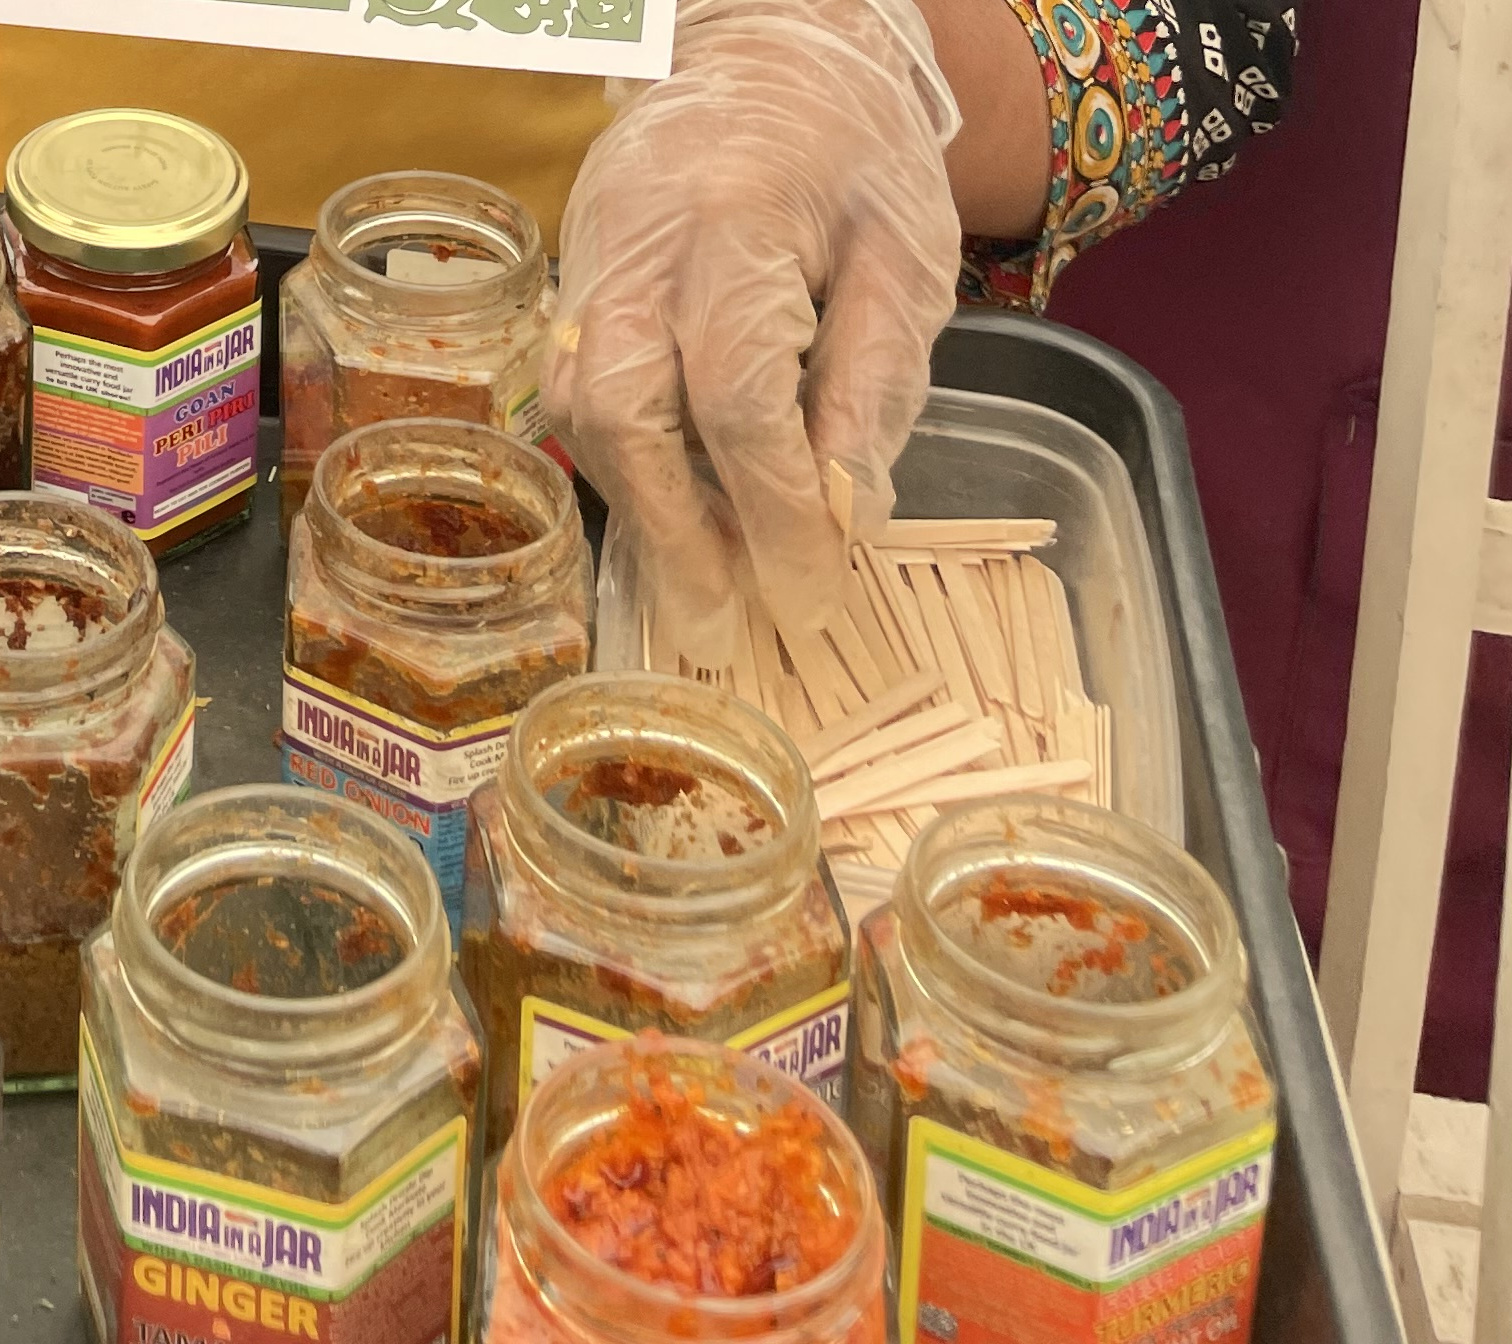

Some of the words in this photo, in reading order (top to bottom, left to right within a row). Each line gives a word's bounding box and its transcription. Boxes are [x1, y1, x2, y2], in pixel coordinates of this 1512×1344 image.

[55, 350, 86, 364] Perhaps
[89, 357, 102, 368] the
[103, 361, 123, 373] most
[85, 384, 98, 393] UK
[155, 349, 202, 397] INDIA
[223, 324, 254, 370] JAR
[153, 417, 203, 457] PERI
[207, 389, 255, 428] PIRI
[174, 380, 235, 424] GOAN
[177, 423, 228, 468] PILI
[297, 698, 354, 758] INDIA
[381, 738, 422, 786] JAR
[464, 743, 493, 760] Splash
[289, 753, 336, 791] RED
[344, 780, 432, 838] ONION
[799, 1014, 842, 1080] JAR
[131, 1183, 221, 1244] INDIA
[263, 1219, 323, 1276] JAR
[133, 1255, 320, 1341] GINGER
